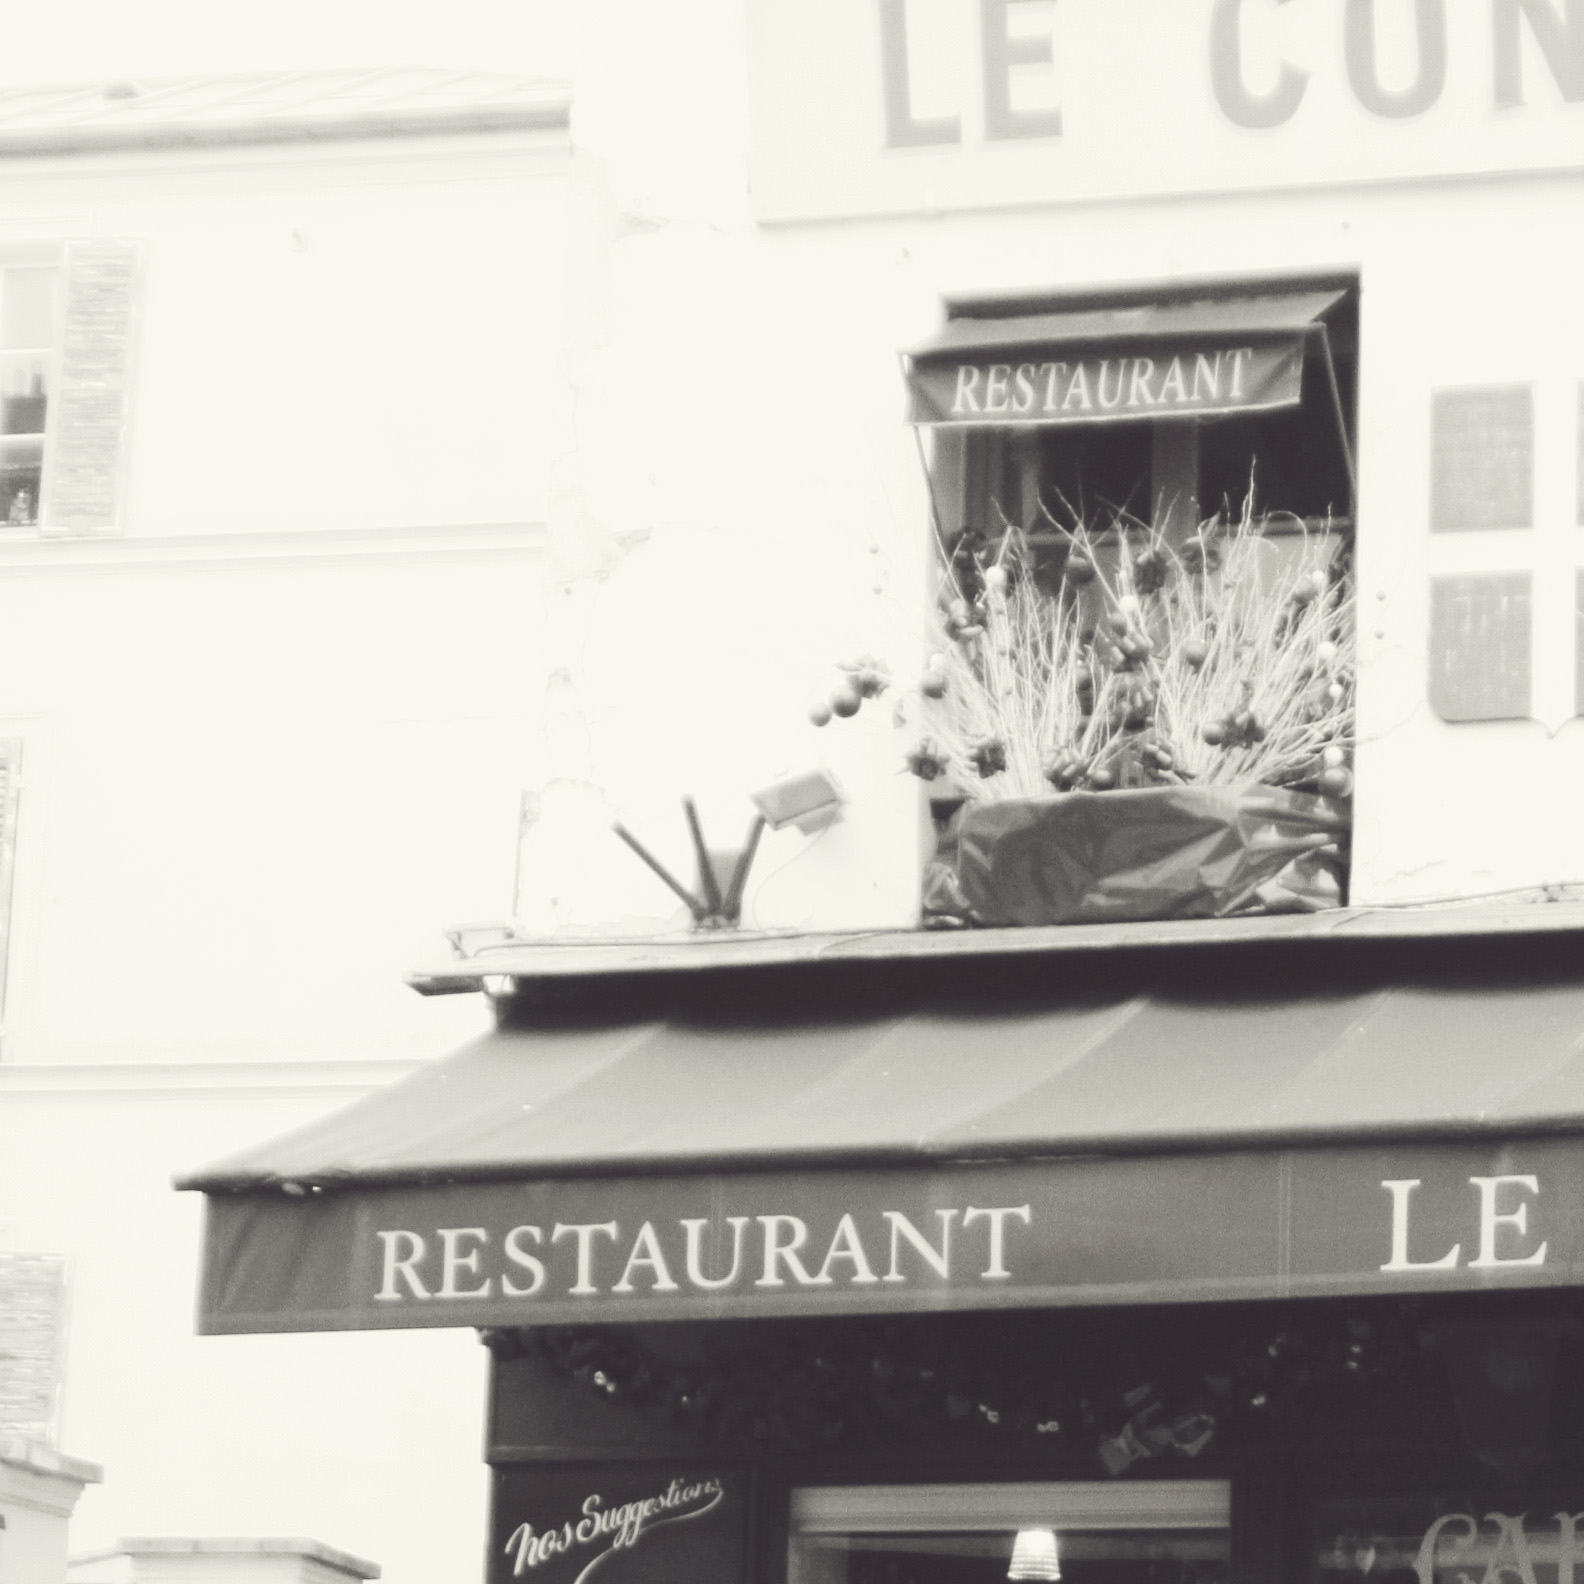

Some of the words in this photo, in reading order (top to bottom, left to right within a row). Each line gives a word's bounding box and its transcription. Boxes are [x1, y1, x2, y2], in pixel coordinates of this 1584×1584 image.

[951, 348, 1253, 413] RESTAURANT
[374, 1205, 1030, 1300] RESTAURANT
[1380, 1175, 1547, 1271] LE
[576, 1477, 724, 1549] Suggestions
